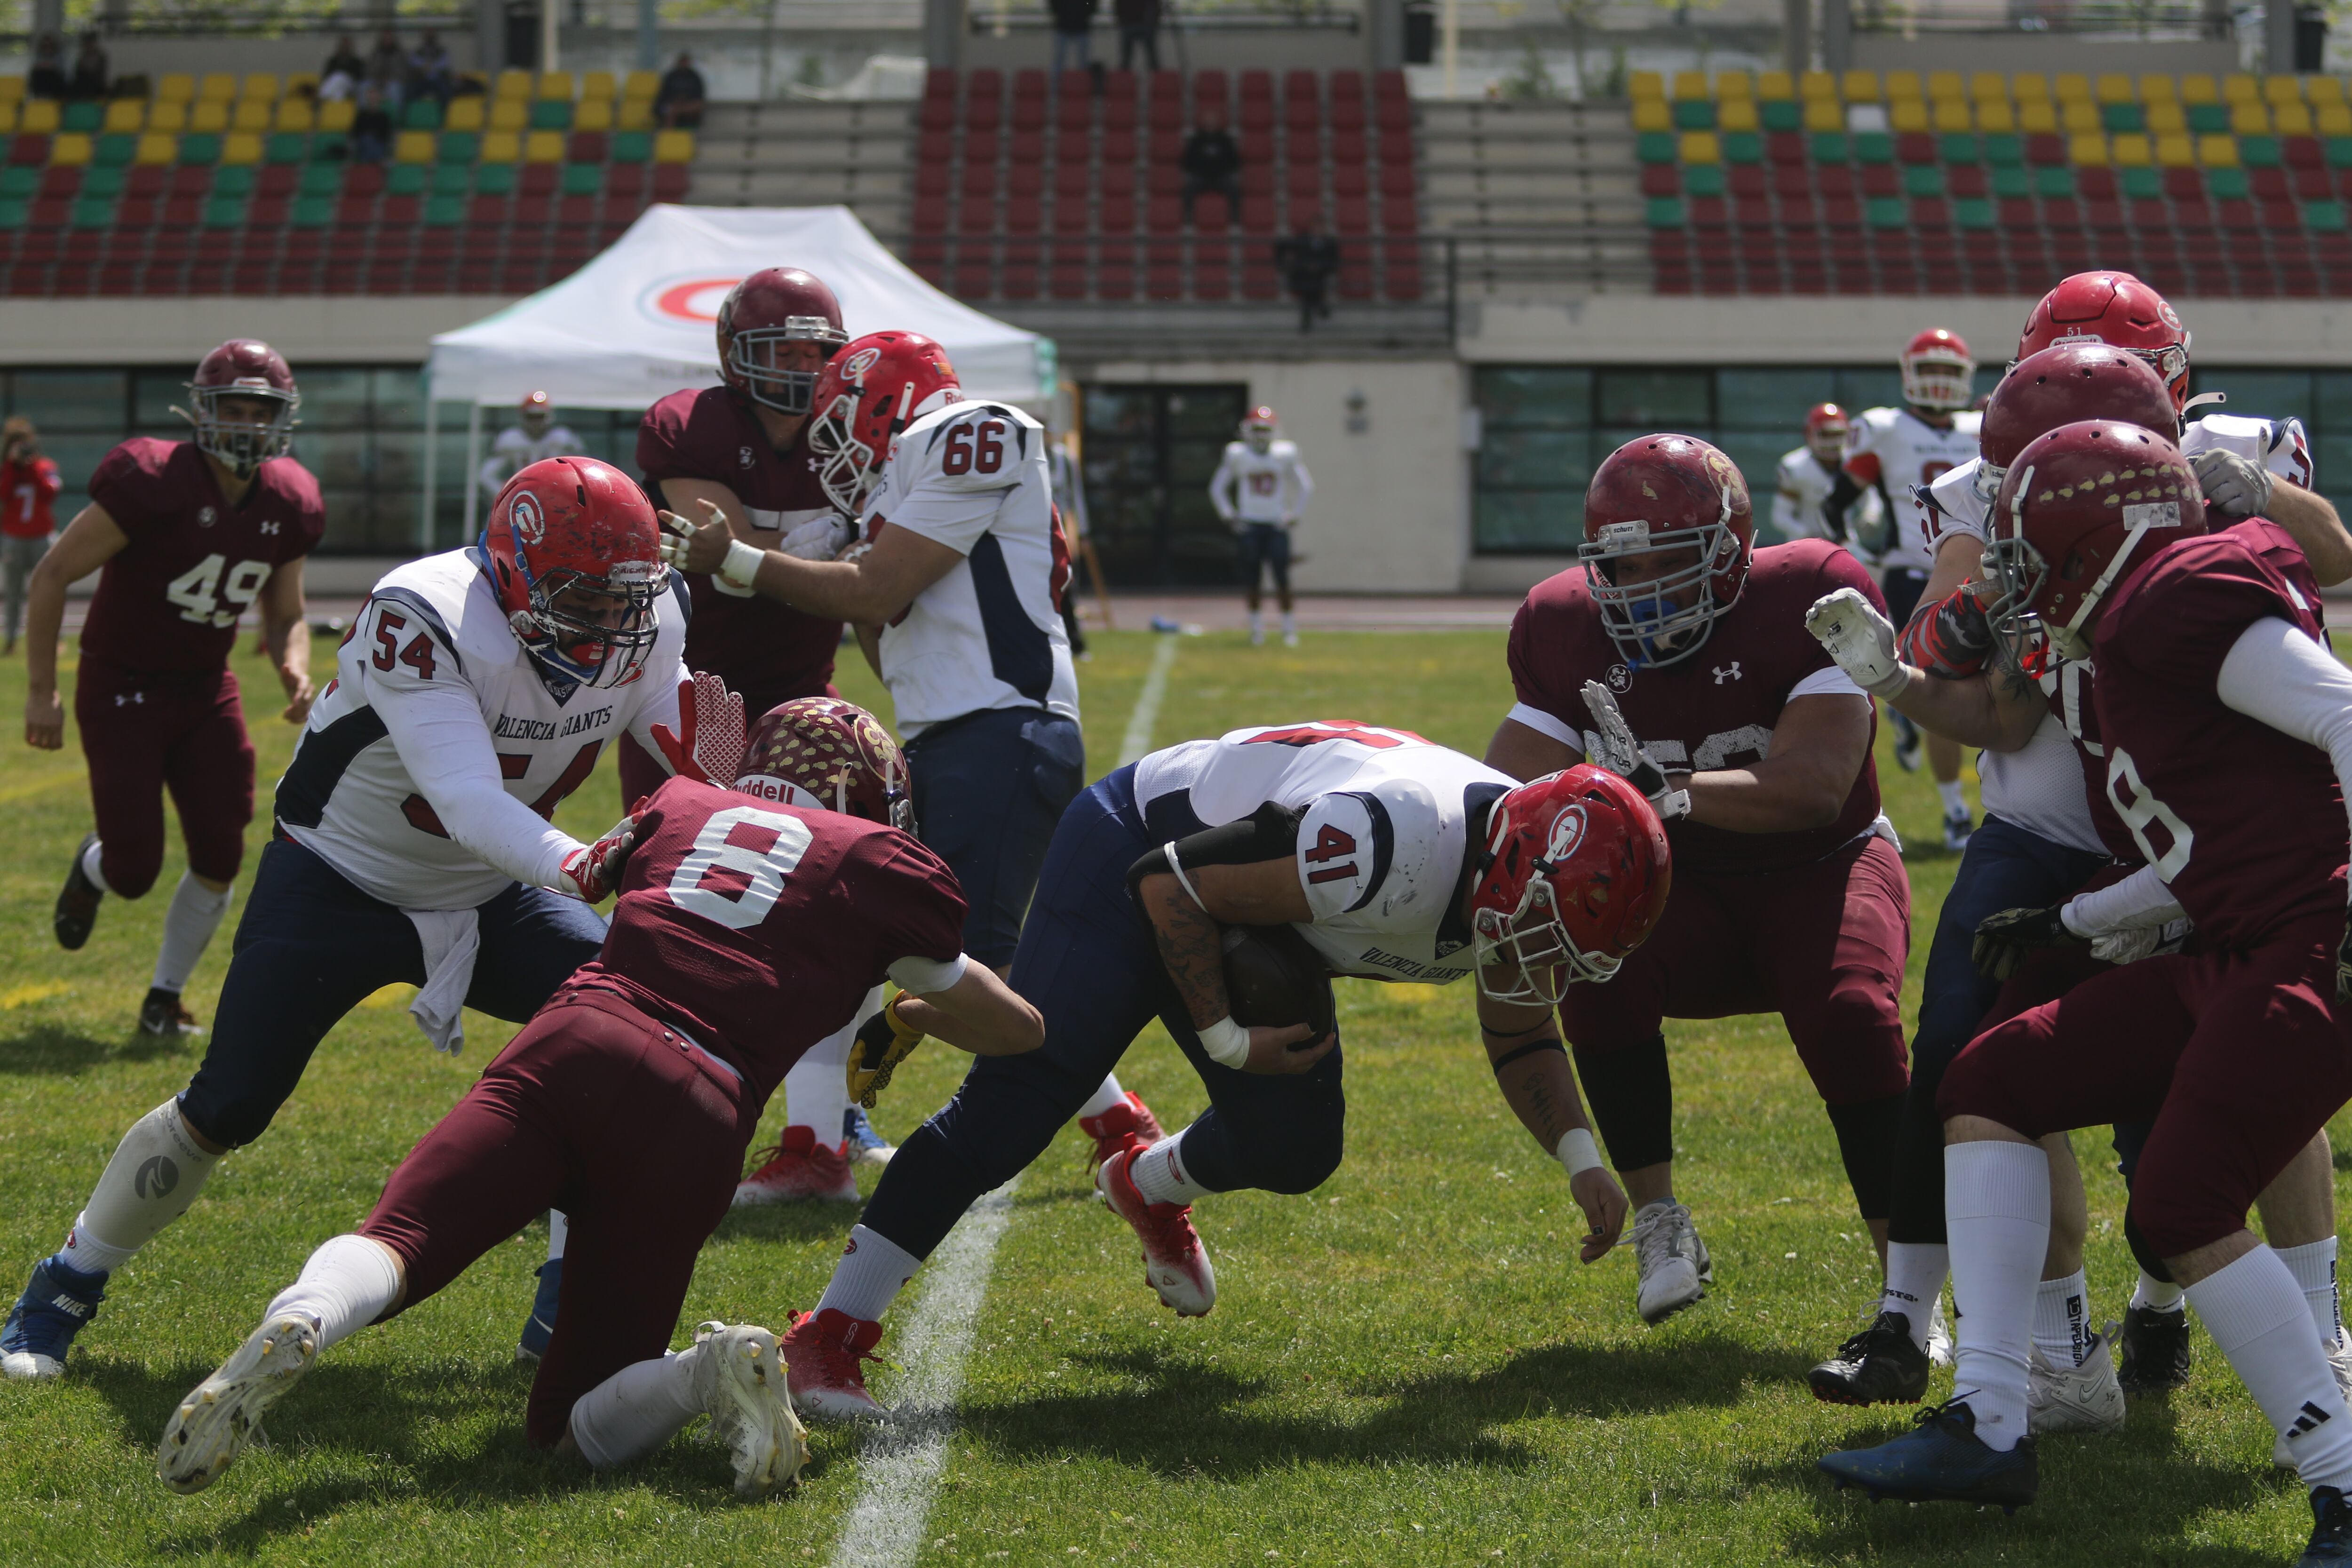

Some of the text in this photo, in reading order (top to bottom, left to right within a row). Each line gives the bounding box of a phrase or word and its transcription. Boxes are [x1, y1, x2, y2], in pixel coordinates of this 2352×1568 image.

[2067, 327, 2082, 336] 51
[943, 422, 1004, 476] 66
[14, 484, 36, 524] 7
[167, 554, 272, 629] 49
[373, 609, 436, 680] 54
[494, 705, 612, 740] VALENCIA GIANTS
[2106, 746, 2194, 884] 8
[664, 805, 814, 930] 8
[1305, 823, 1359, 885] 41
[1359, 947, 1474, 980] VALENCIA GIANTS
[51, 1294, 88, 1317] NIKE
